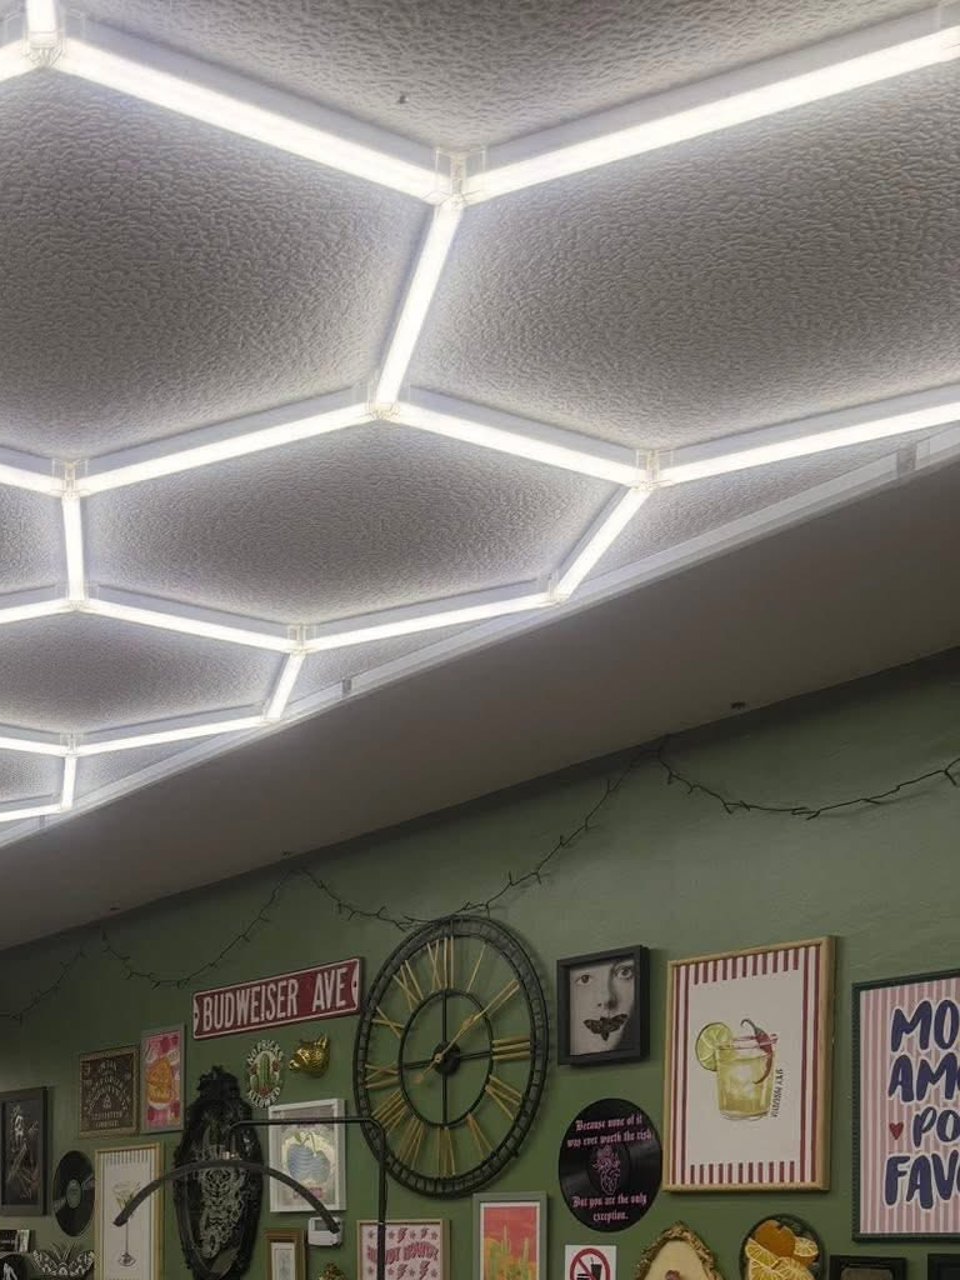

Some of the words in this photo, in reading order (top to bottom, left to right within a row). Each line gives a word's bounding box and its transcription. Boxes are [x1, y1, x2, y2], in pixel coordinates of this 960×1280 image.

[202, 980, 299, 1032] BUDWEISER
[311, 967, 350, 1012] AVE
[888, 1053, 960, 1103] AM
[575, 1119, 606, 1131] Because
[607, 1117, 624, 1128] none
[626, 1114, 635, 1126] of
[636, 1112, 643, 1125] it
[583, 1136, 598, 1147] ever
[599, 1131, 622, 1145] worth
[623, 1129, 635, 1141] the
[636, 1127, 652, 1141] risk
[885, 1149, 960, 1210] FAV
[571, 1195, 588, 1207] But
[589, 1197, 603, 1209] you
[604, 1197, 616, 1206] are
[617, 1192, 629, 1205] the
[630, 1191, 647, 1206] only
